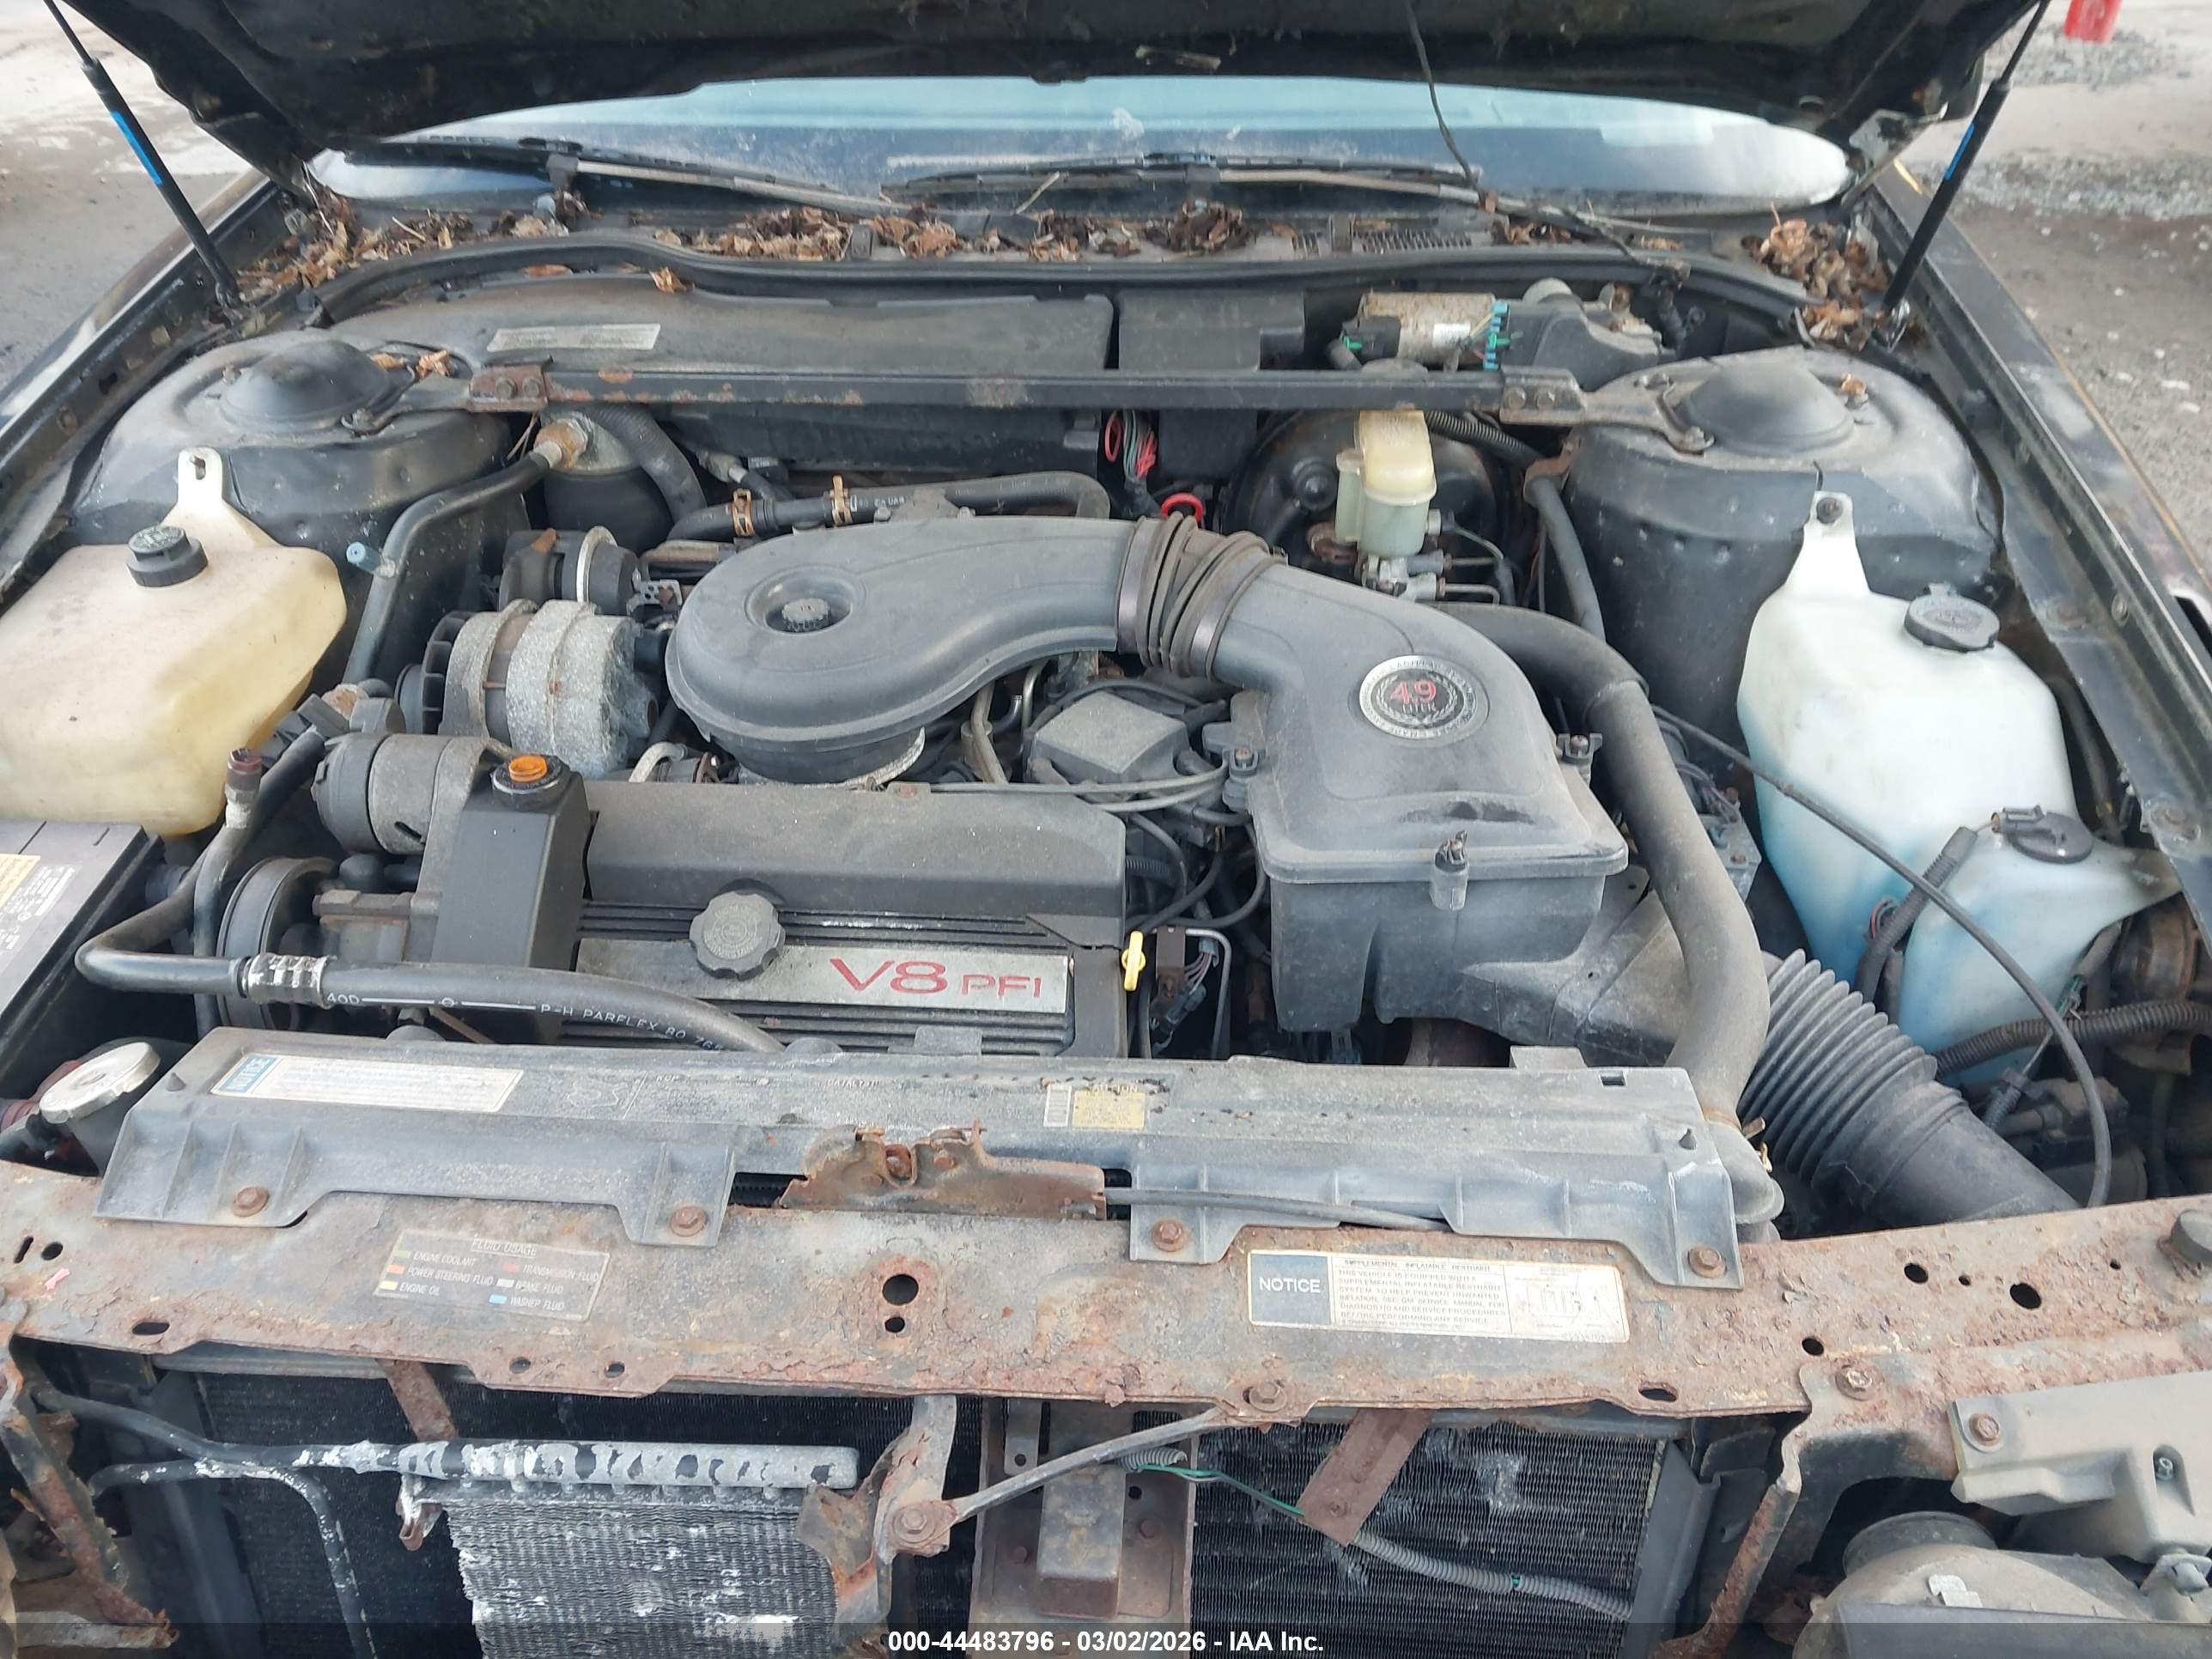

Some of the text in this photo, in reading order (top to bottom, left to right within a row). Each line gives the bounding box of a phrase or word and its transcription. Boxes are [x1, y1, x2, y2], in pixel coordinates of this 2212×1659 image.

[830, 957, 1042, 998] V8 PFI
[583, 1009, 659, 1031] PARFLEX
[472, 1238, 537, 1256] FLUID USAGE
[408, 1266, 495, 1286] POWER STEERING FLUID
[1259, 1277, 1322, 1293] NOTICE
[399, 1282, 428, 1294] ENGINE
[543, 1300, 564, 1312] FLUID
